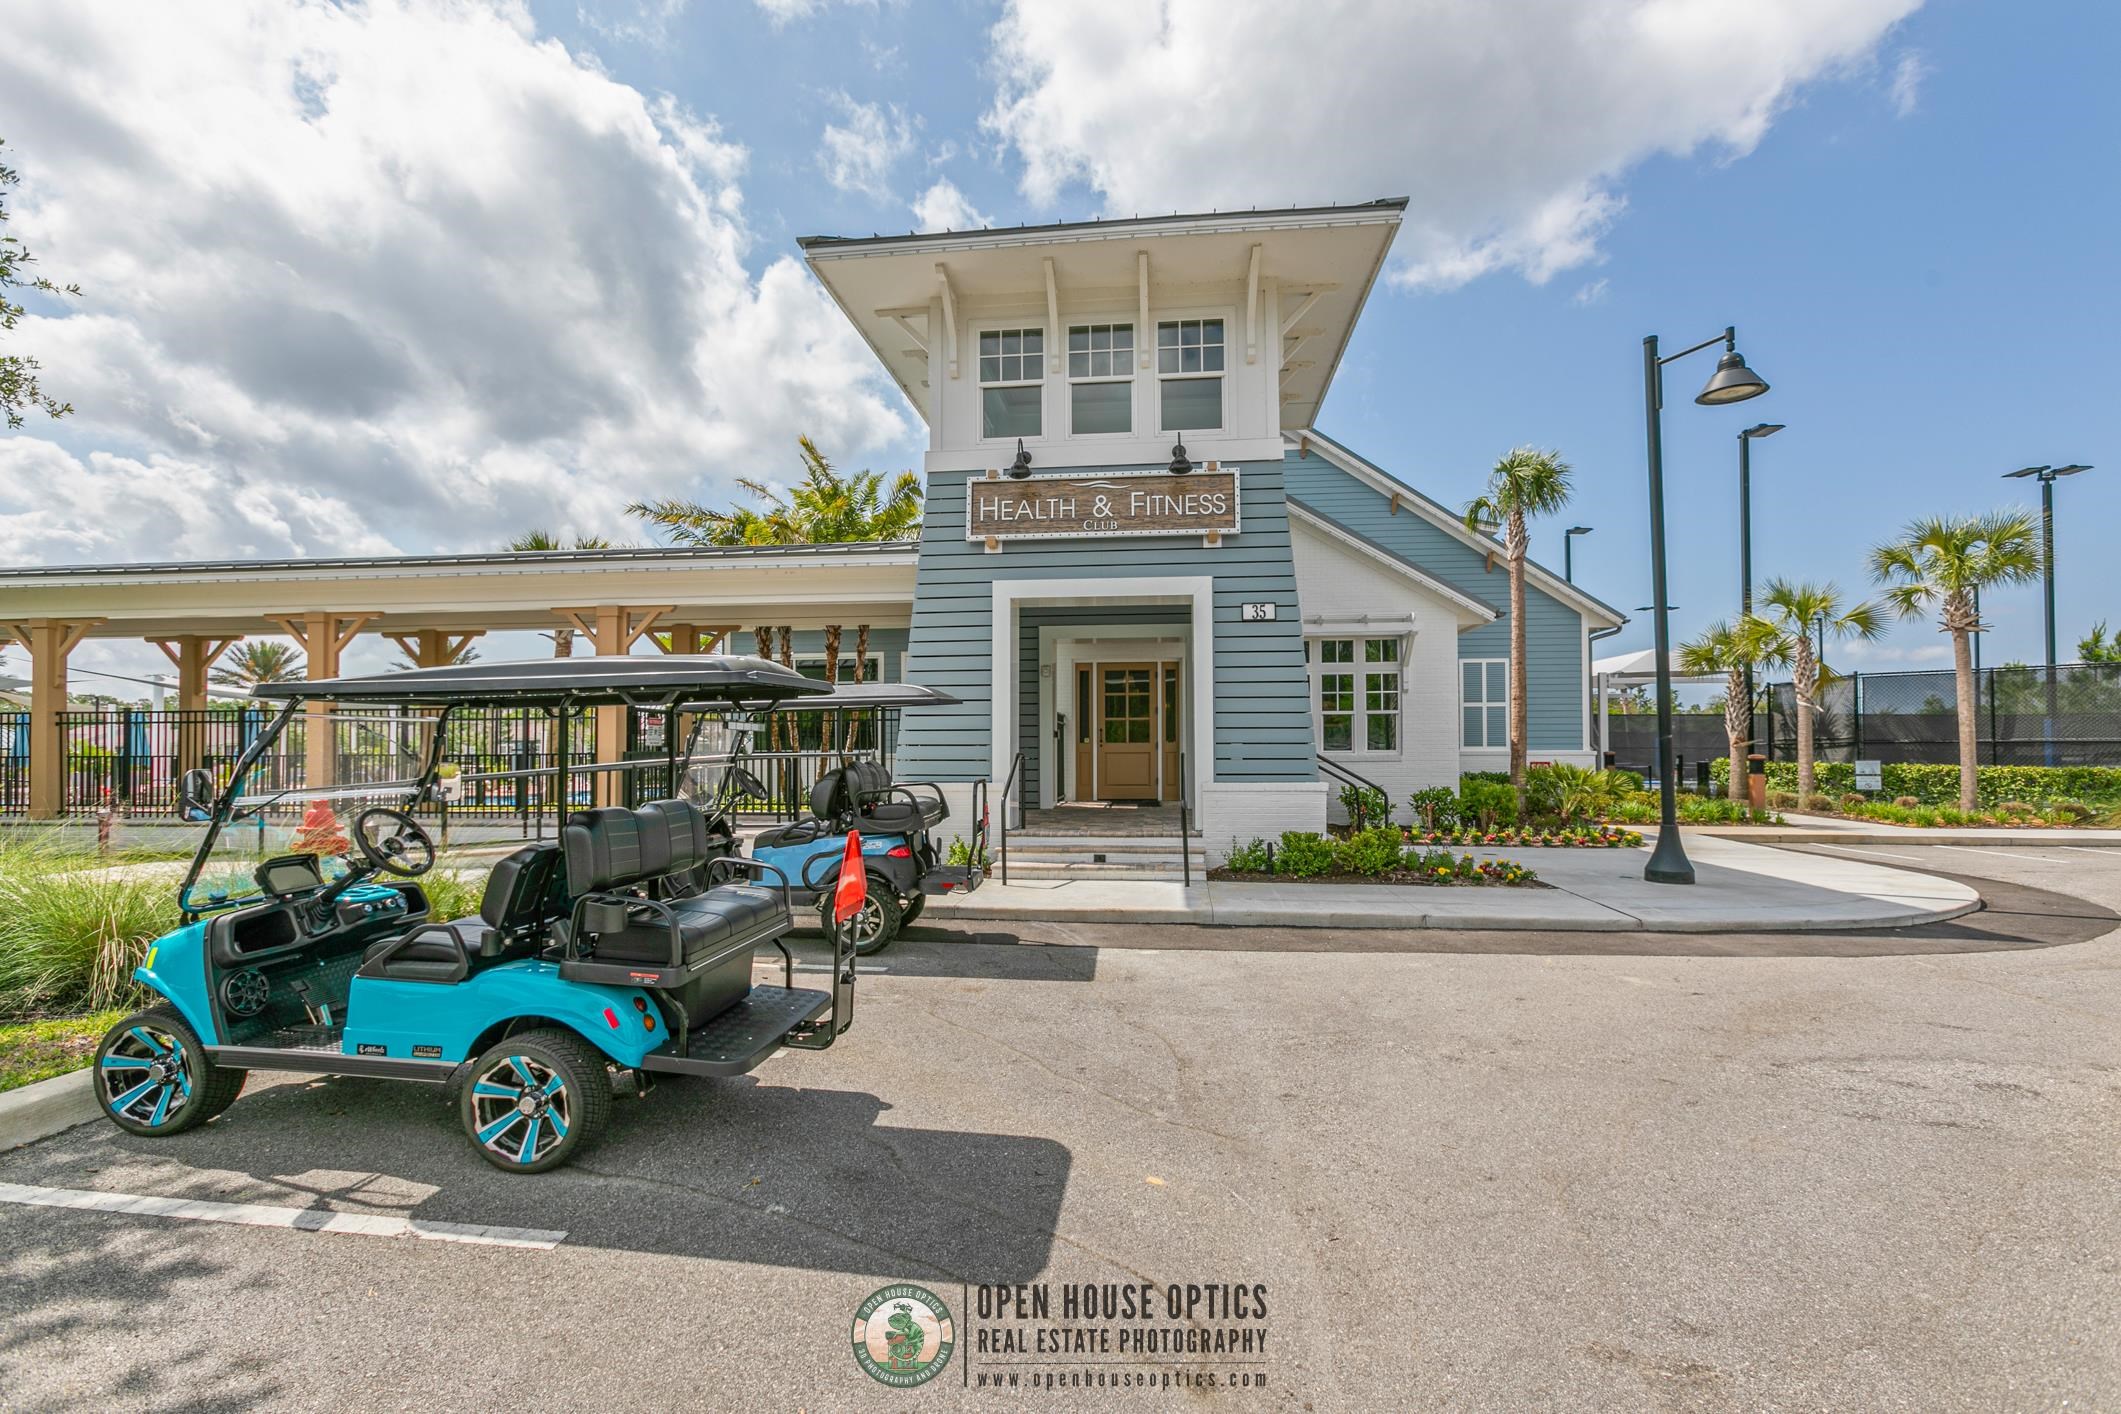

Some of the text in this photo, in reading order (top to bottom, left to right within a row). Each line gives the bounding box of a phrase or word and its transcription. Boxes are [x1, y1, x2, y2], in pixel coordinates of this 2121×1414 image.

[979, 491, 1227, 521] HEALTH & FITNESS
[1083, 519, 1118, 531] CLUB
[1251, 604, 1267, 620] 35
